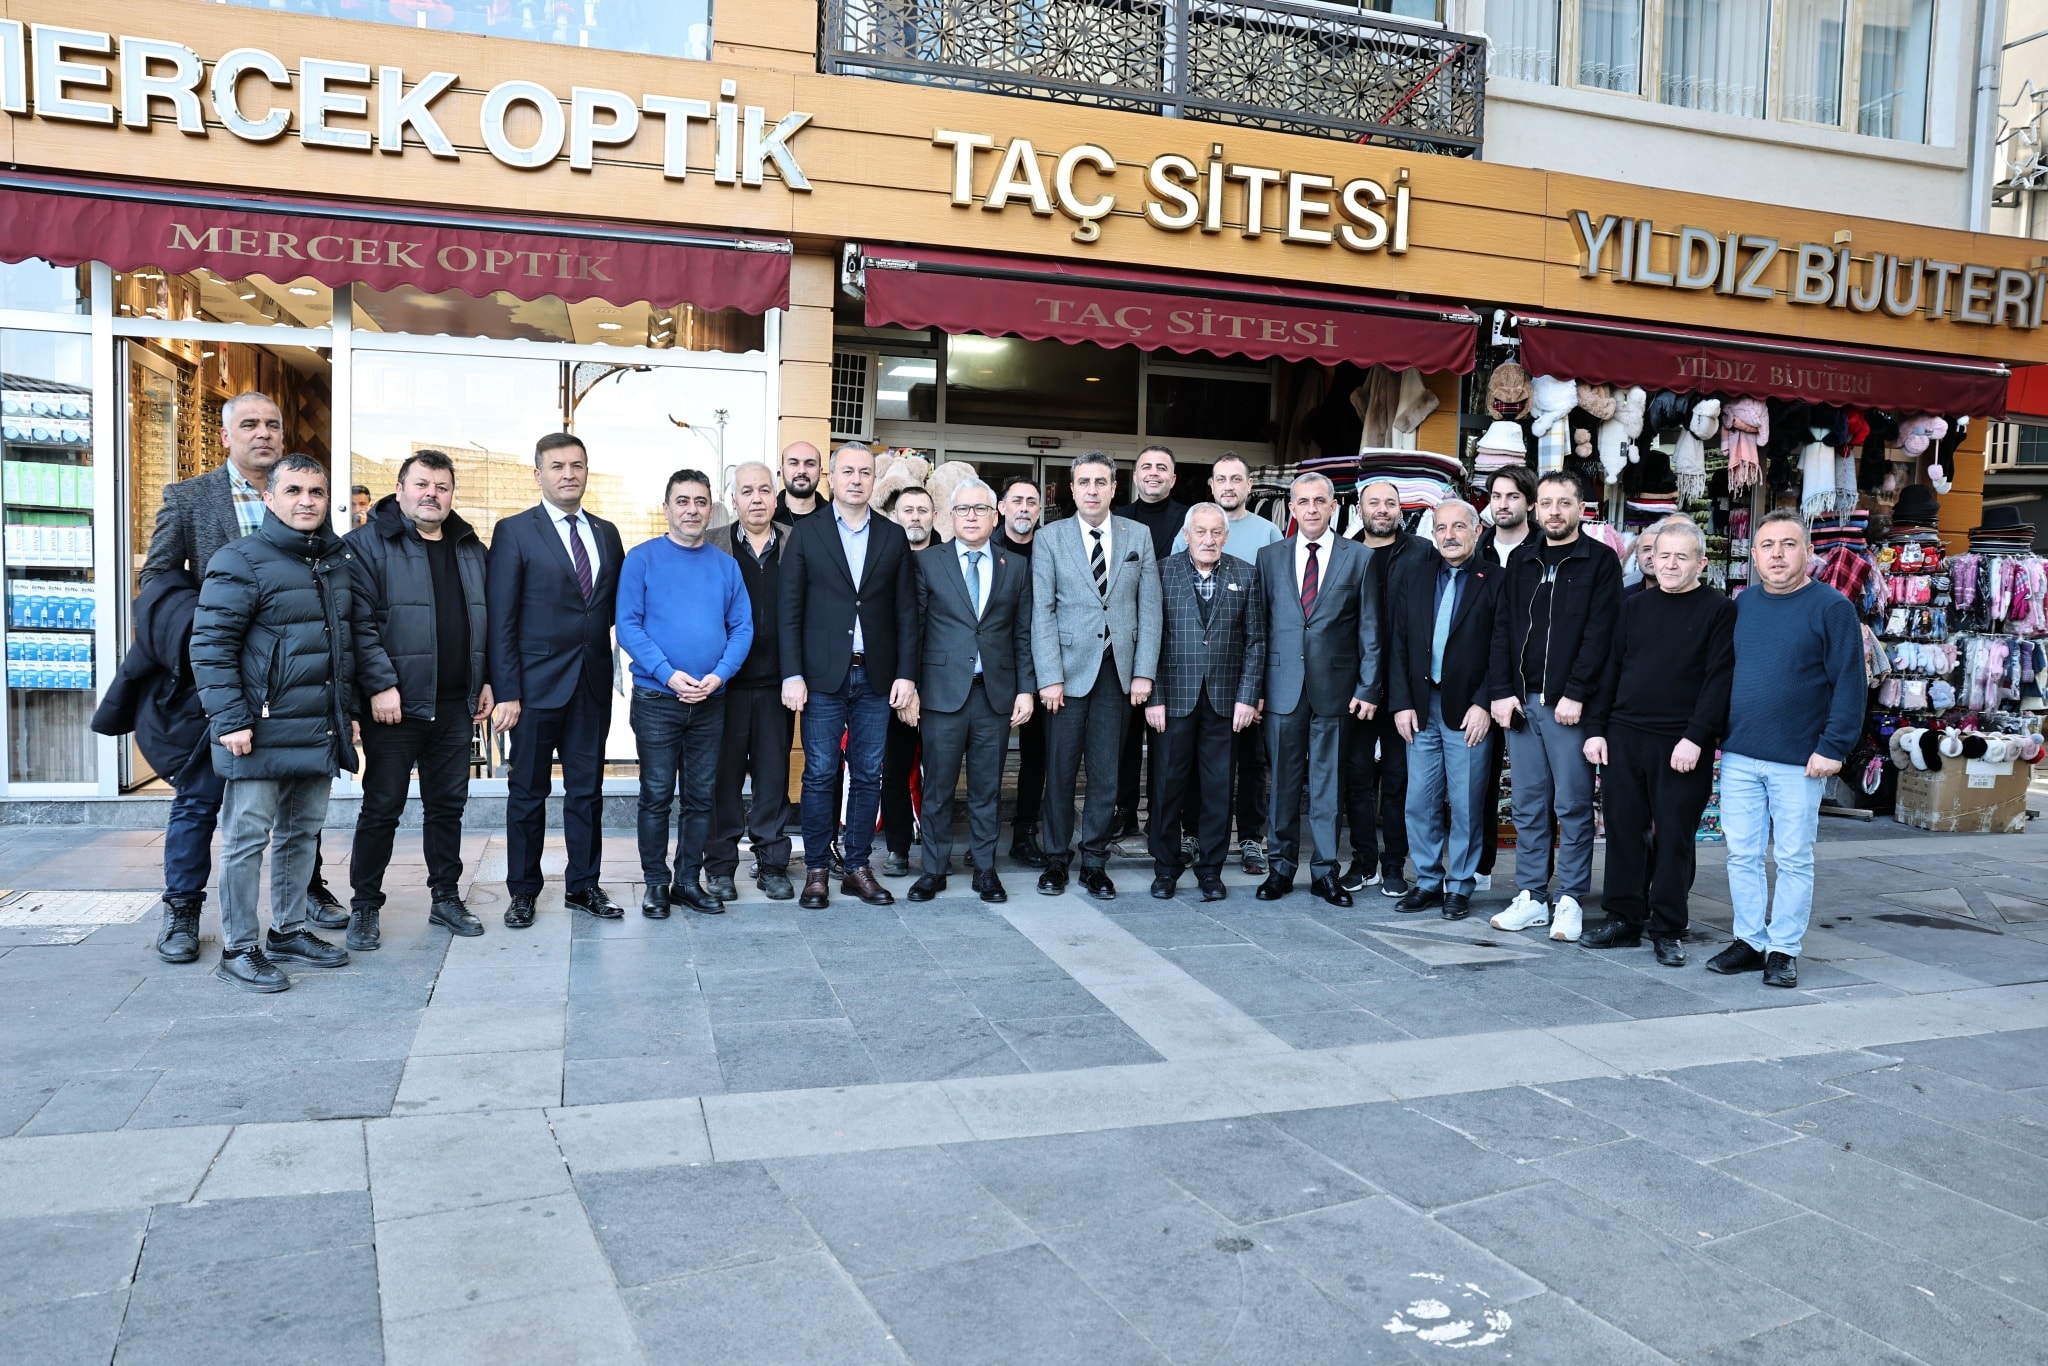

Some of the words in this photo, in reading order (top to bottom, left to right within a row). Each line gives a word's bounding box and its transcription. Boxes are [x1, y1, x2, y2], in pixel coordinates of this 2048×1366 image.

[479, 78, 813, 193] OPTİK
[931, 127, 1117, 243] TAÇ
[1142, 141, 1411, 256] SİTESİ
[167, 223, 424, 269] MERCEK
[436, 245, 613, 282] OPTİK
[1566, 208, 1780, 299] YILDIZ
[1787, 230, 2048, 329] BİJUTERİ
[1035, 298, 1153, 337] TAÇ
[1167, 307, 1340, 347] SİTESİ
[1675, 355, 1759, 384] YILDIZ
[1769, 364, 1874, 395] BİJUTERİ
